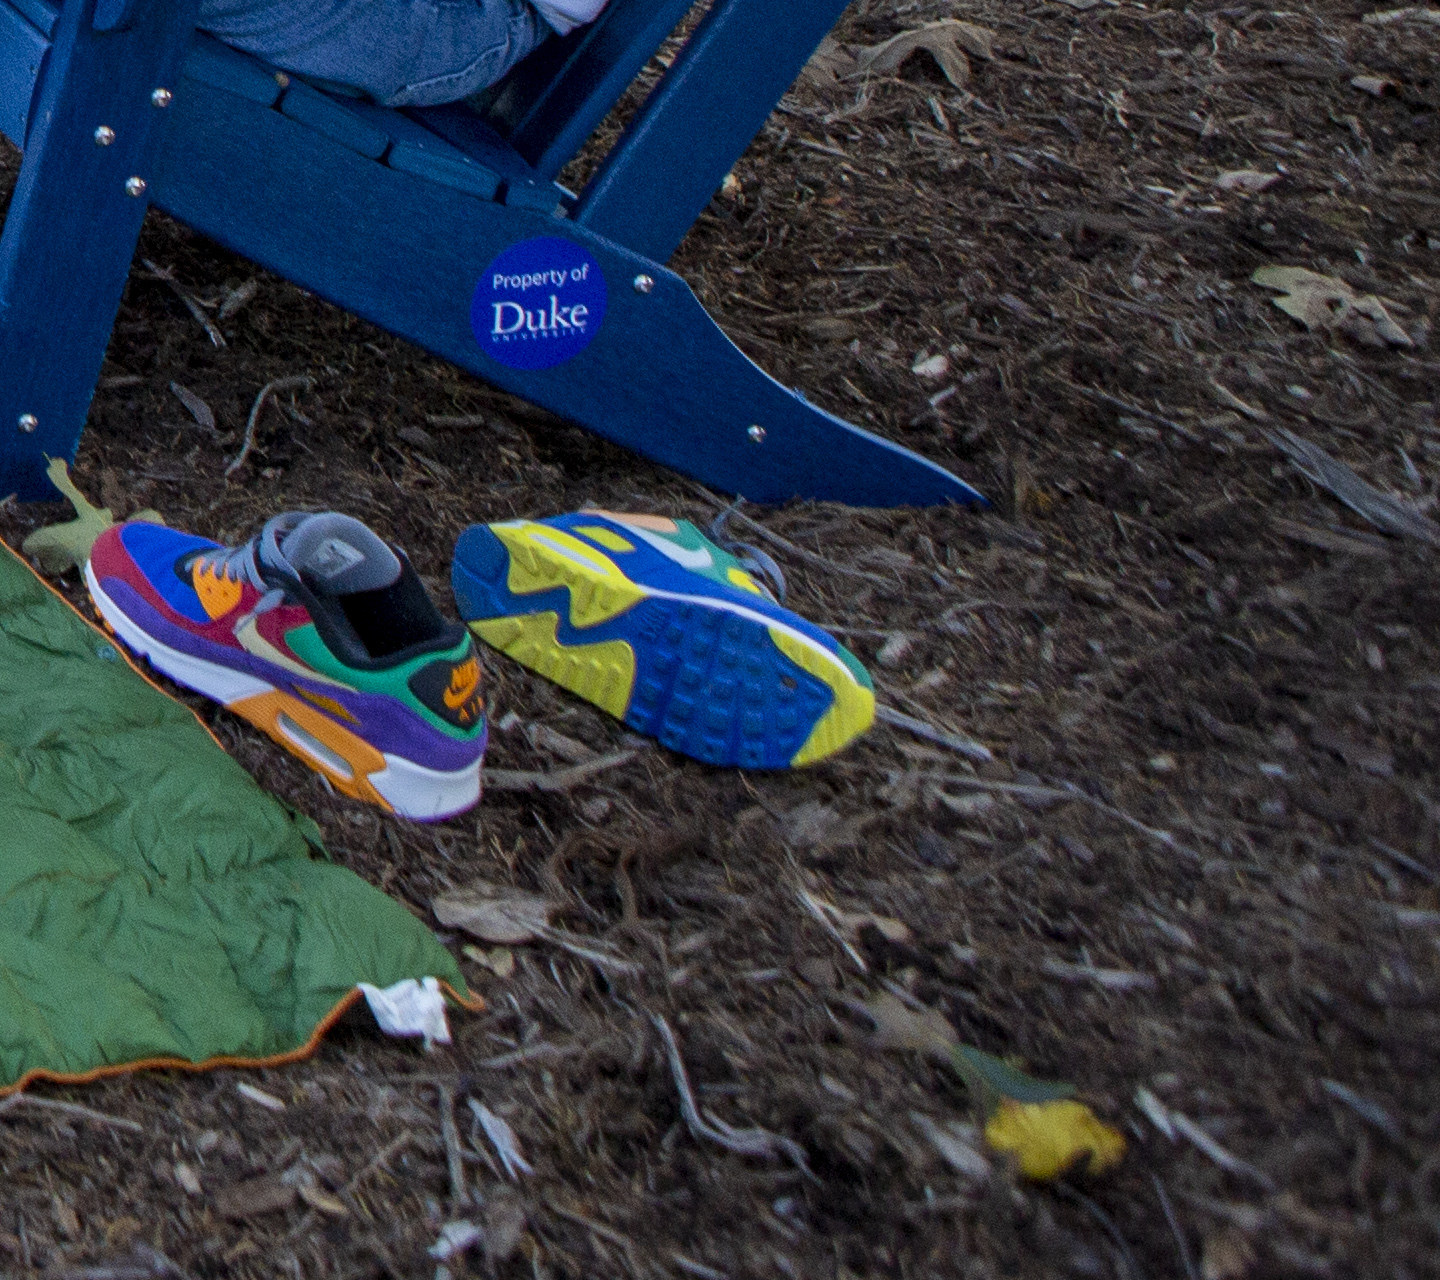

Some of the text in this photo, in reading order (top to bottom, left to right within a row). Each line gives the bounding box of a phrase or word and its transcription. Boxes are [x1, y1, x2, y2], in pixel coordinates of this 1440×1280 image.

[492, 263, 590, 292] Property of
[491, 294, 589, 335] Duke
